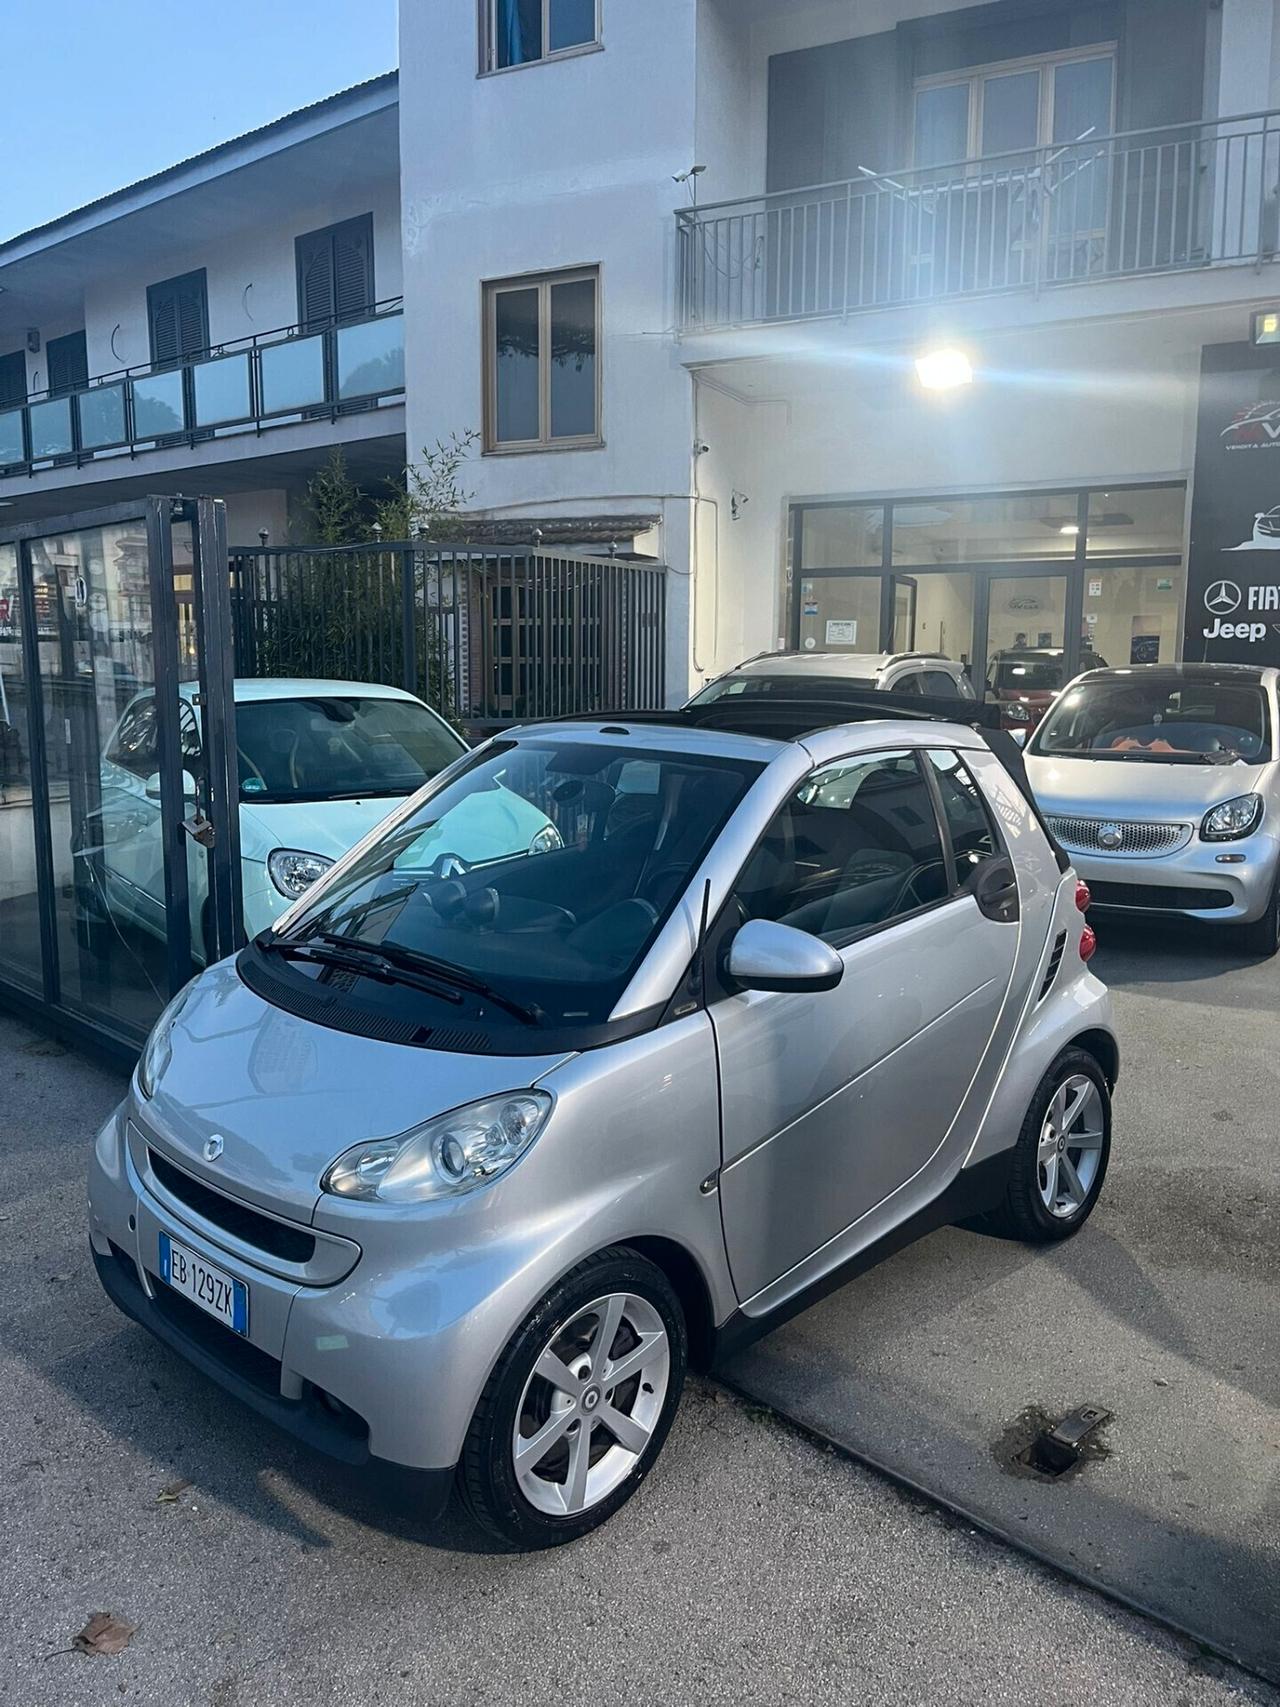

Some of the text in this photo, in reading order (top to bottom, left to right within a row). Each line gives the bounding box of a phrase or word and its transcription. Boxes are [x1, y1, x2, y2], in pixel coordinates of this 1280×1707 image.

[1248, 586, 1280, 610] FIA
[1203, 618, 1266, 642] Jeep
[171, 1249, 232, 1317] EB 129ZK
